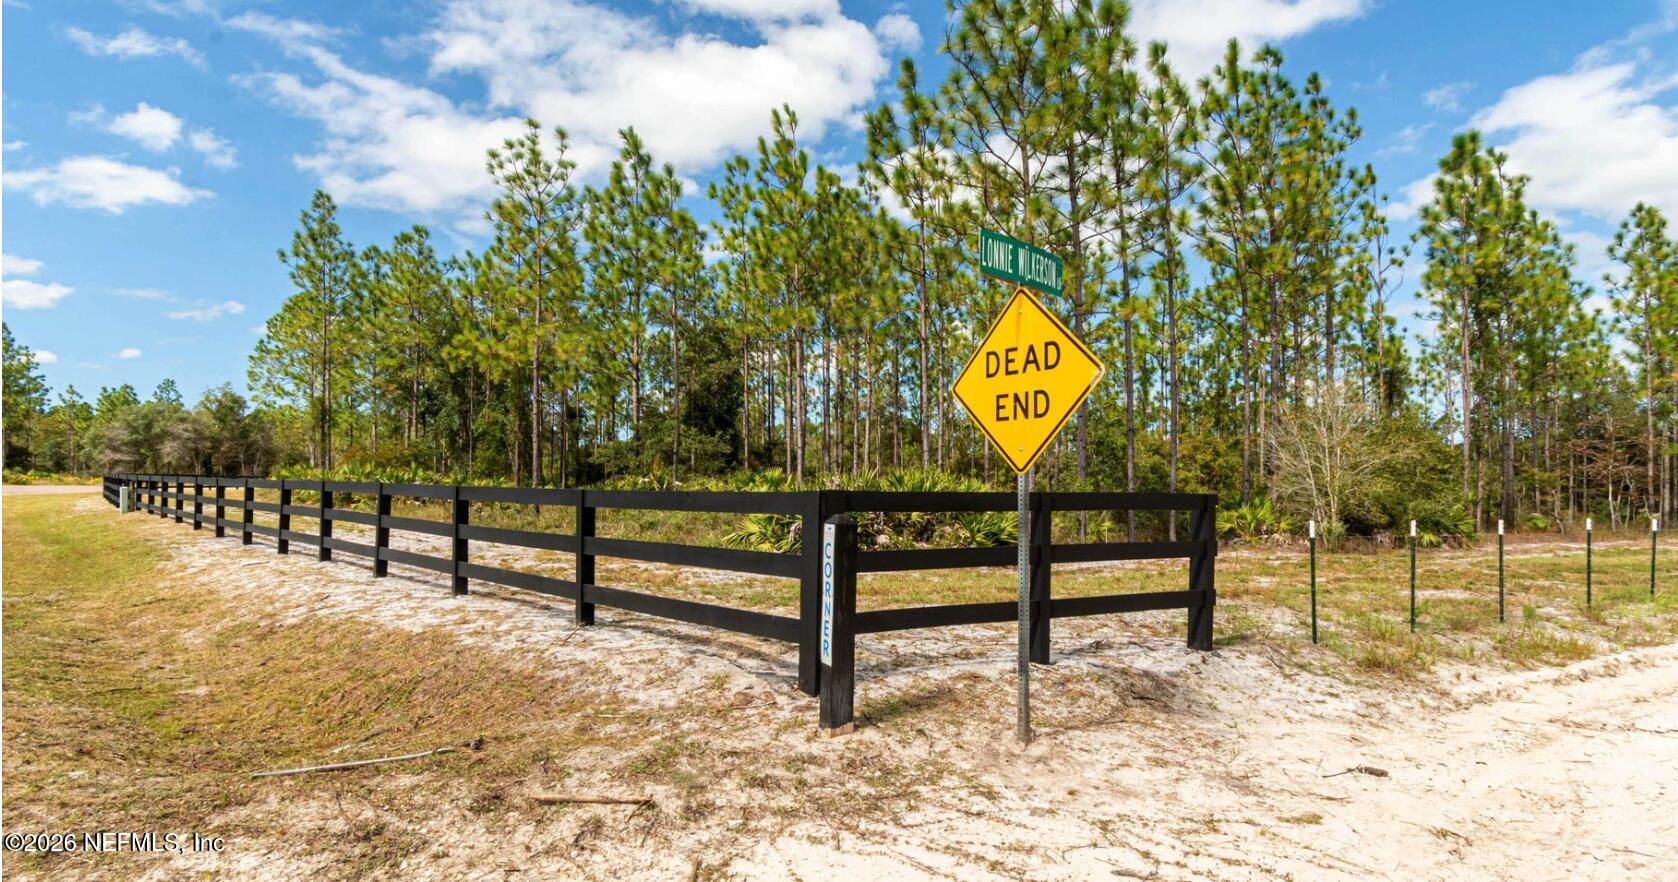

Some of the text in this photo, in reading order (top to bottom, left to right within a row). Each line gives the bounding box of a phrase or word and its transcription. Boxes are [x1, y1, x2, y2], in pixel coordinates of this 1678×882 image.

[982, 236, 1057, 288] LONNIE WILKERSON
[985, 341, 1061, 379] DEAD
[996, 390, 1050, 422] END
[823, 542, 832, 657] CORNER
